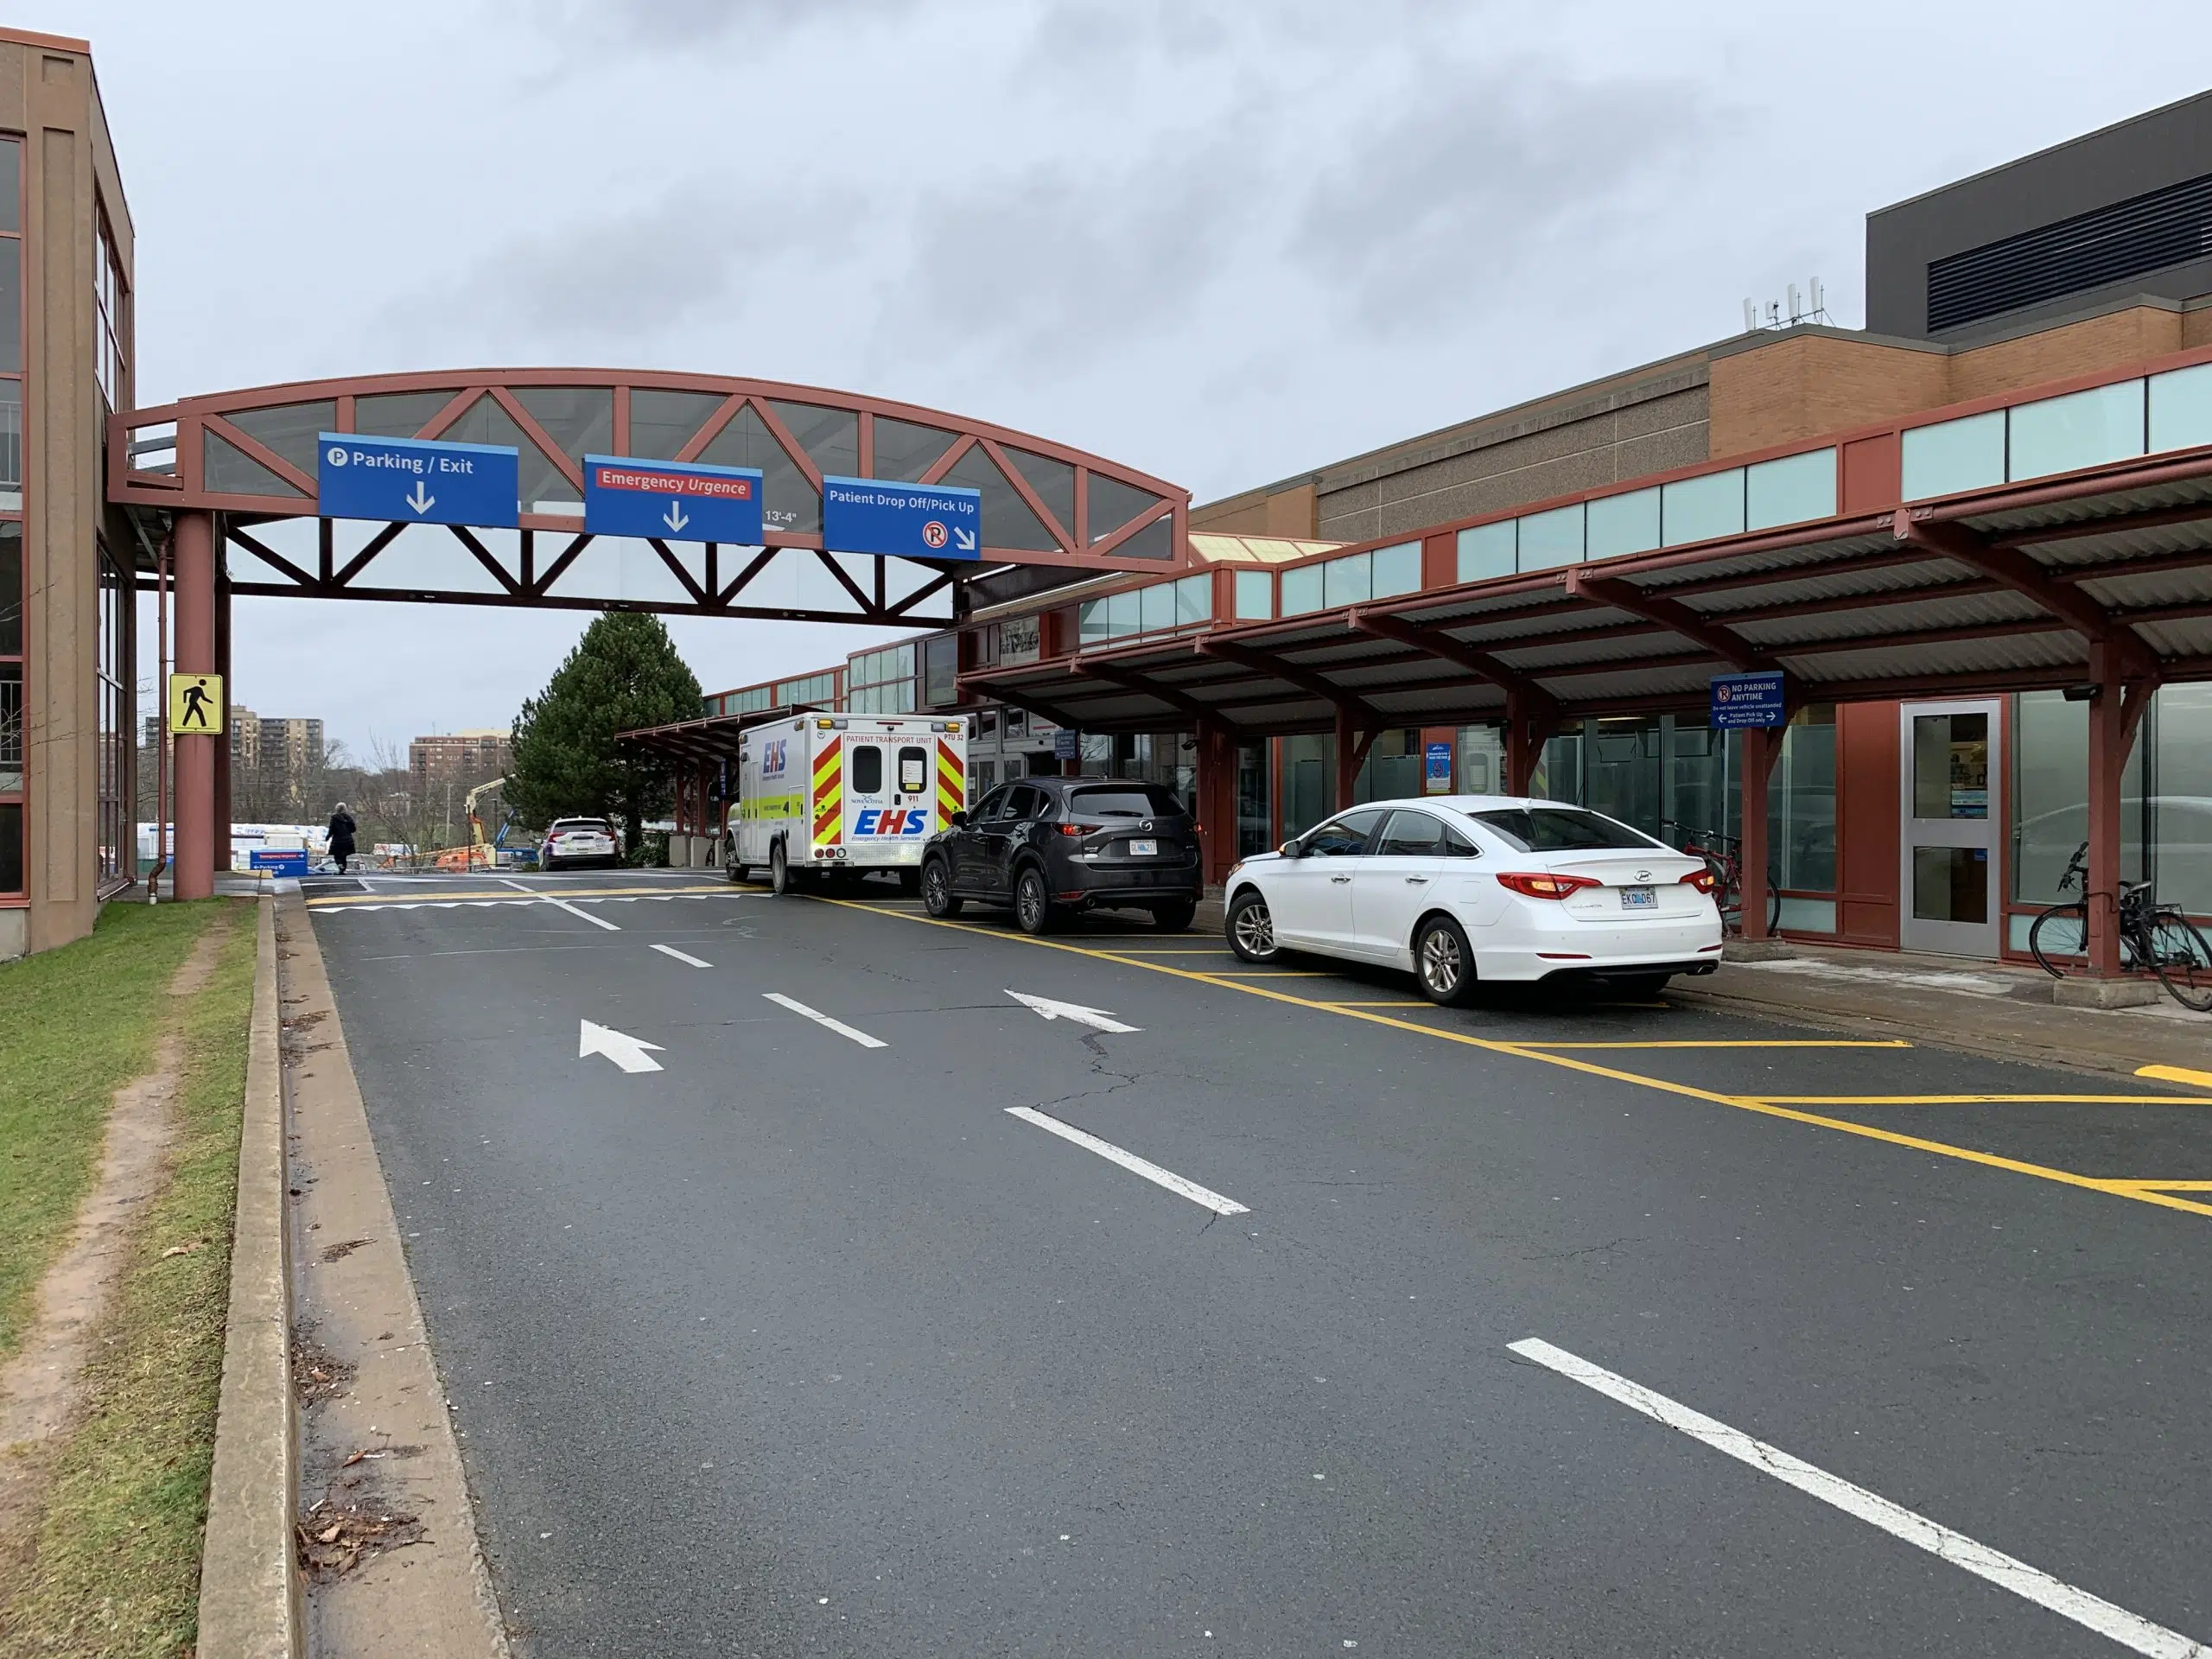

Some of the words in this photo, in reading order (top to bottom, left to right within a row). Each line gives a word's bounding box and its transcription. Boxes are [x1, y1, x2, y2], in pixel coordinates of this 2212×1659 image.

[353, 451, 423, 474] Parking
[440, 458, 474, 474] Exit
[602, 470, 684, 493] Emergency
[688, 478, 747, 495] Urgence
[830, 490, 874, 505] Patient
[877, 494, 906, 509] Drop
[909, 497, 956, 512] Off/Pick
[958, 501, 975, 515] Up
[1744, 682, 1777, 691] PARKING
[763, 739, 787, 773] EHS
[854, 810, 928, 835] EHS
